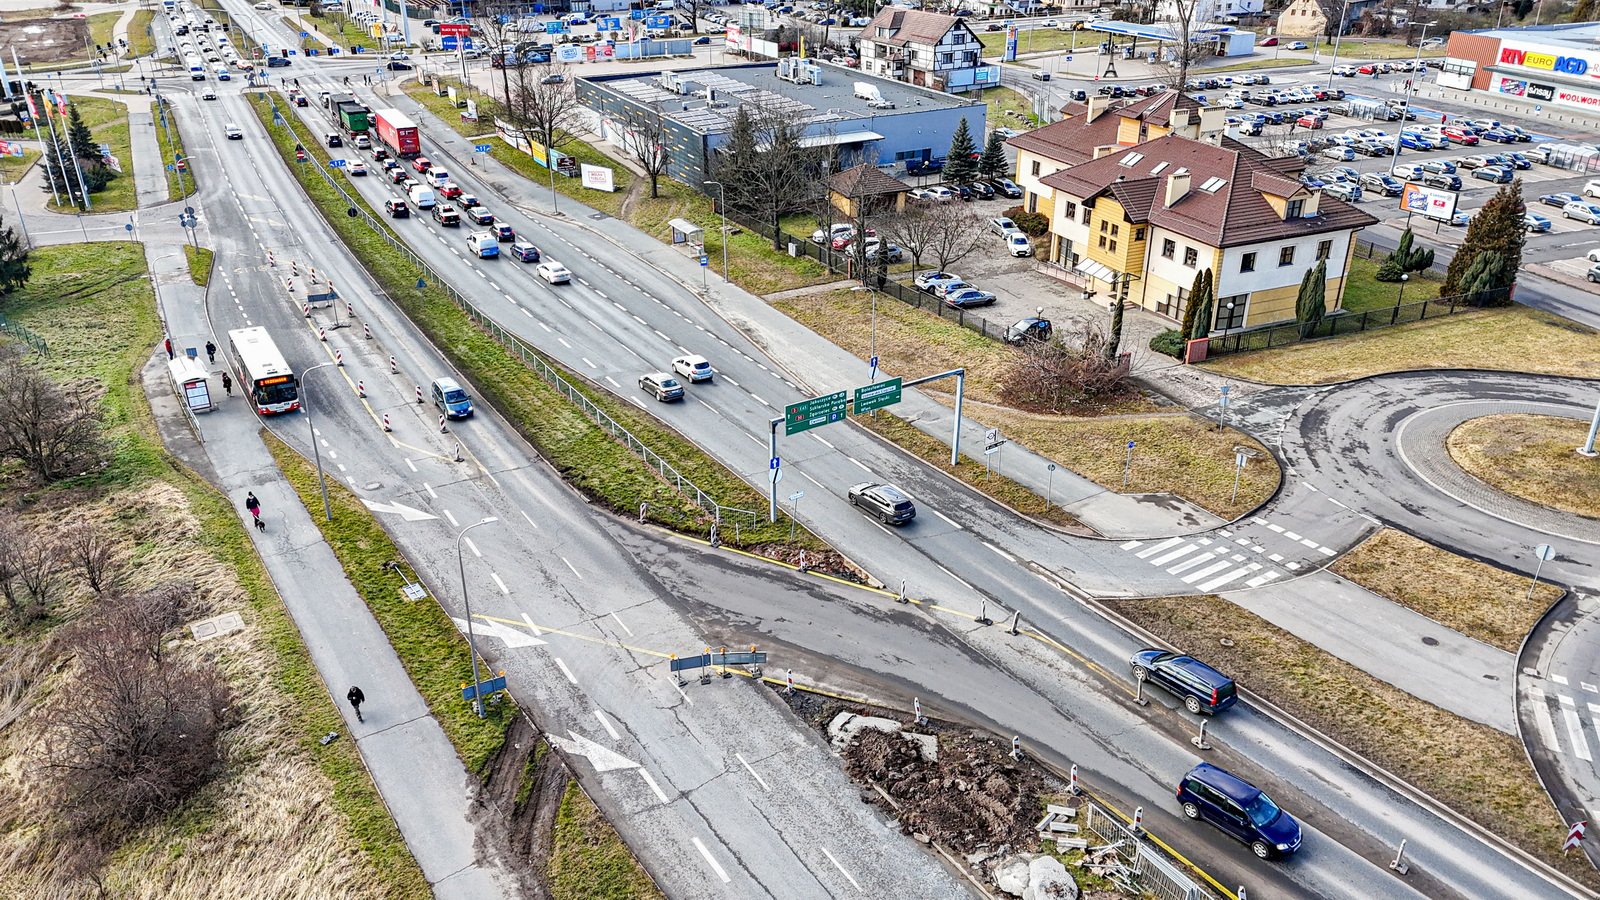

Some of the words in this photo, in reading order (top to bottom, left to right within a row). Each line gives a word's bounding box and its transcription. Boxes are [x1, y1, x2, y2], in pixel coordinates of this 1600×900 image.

[1500, 48, 1527, 65] RTV
[1526, 56, 1552, 66] EURO
[1554, 56, 1588, 75] AGD
[1528, 85, 1552, 99] sinsay
